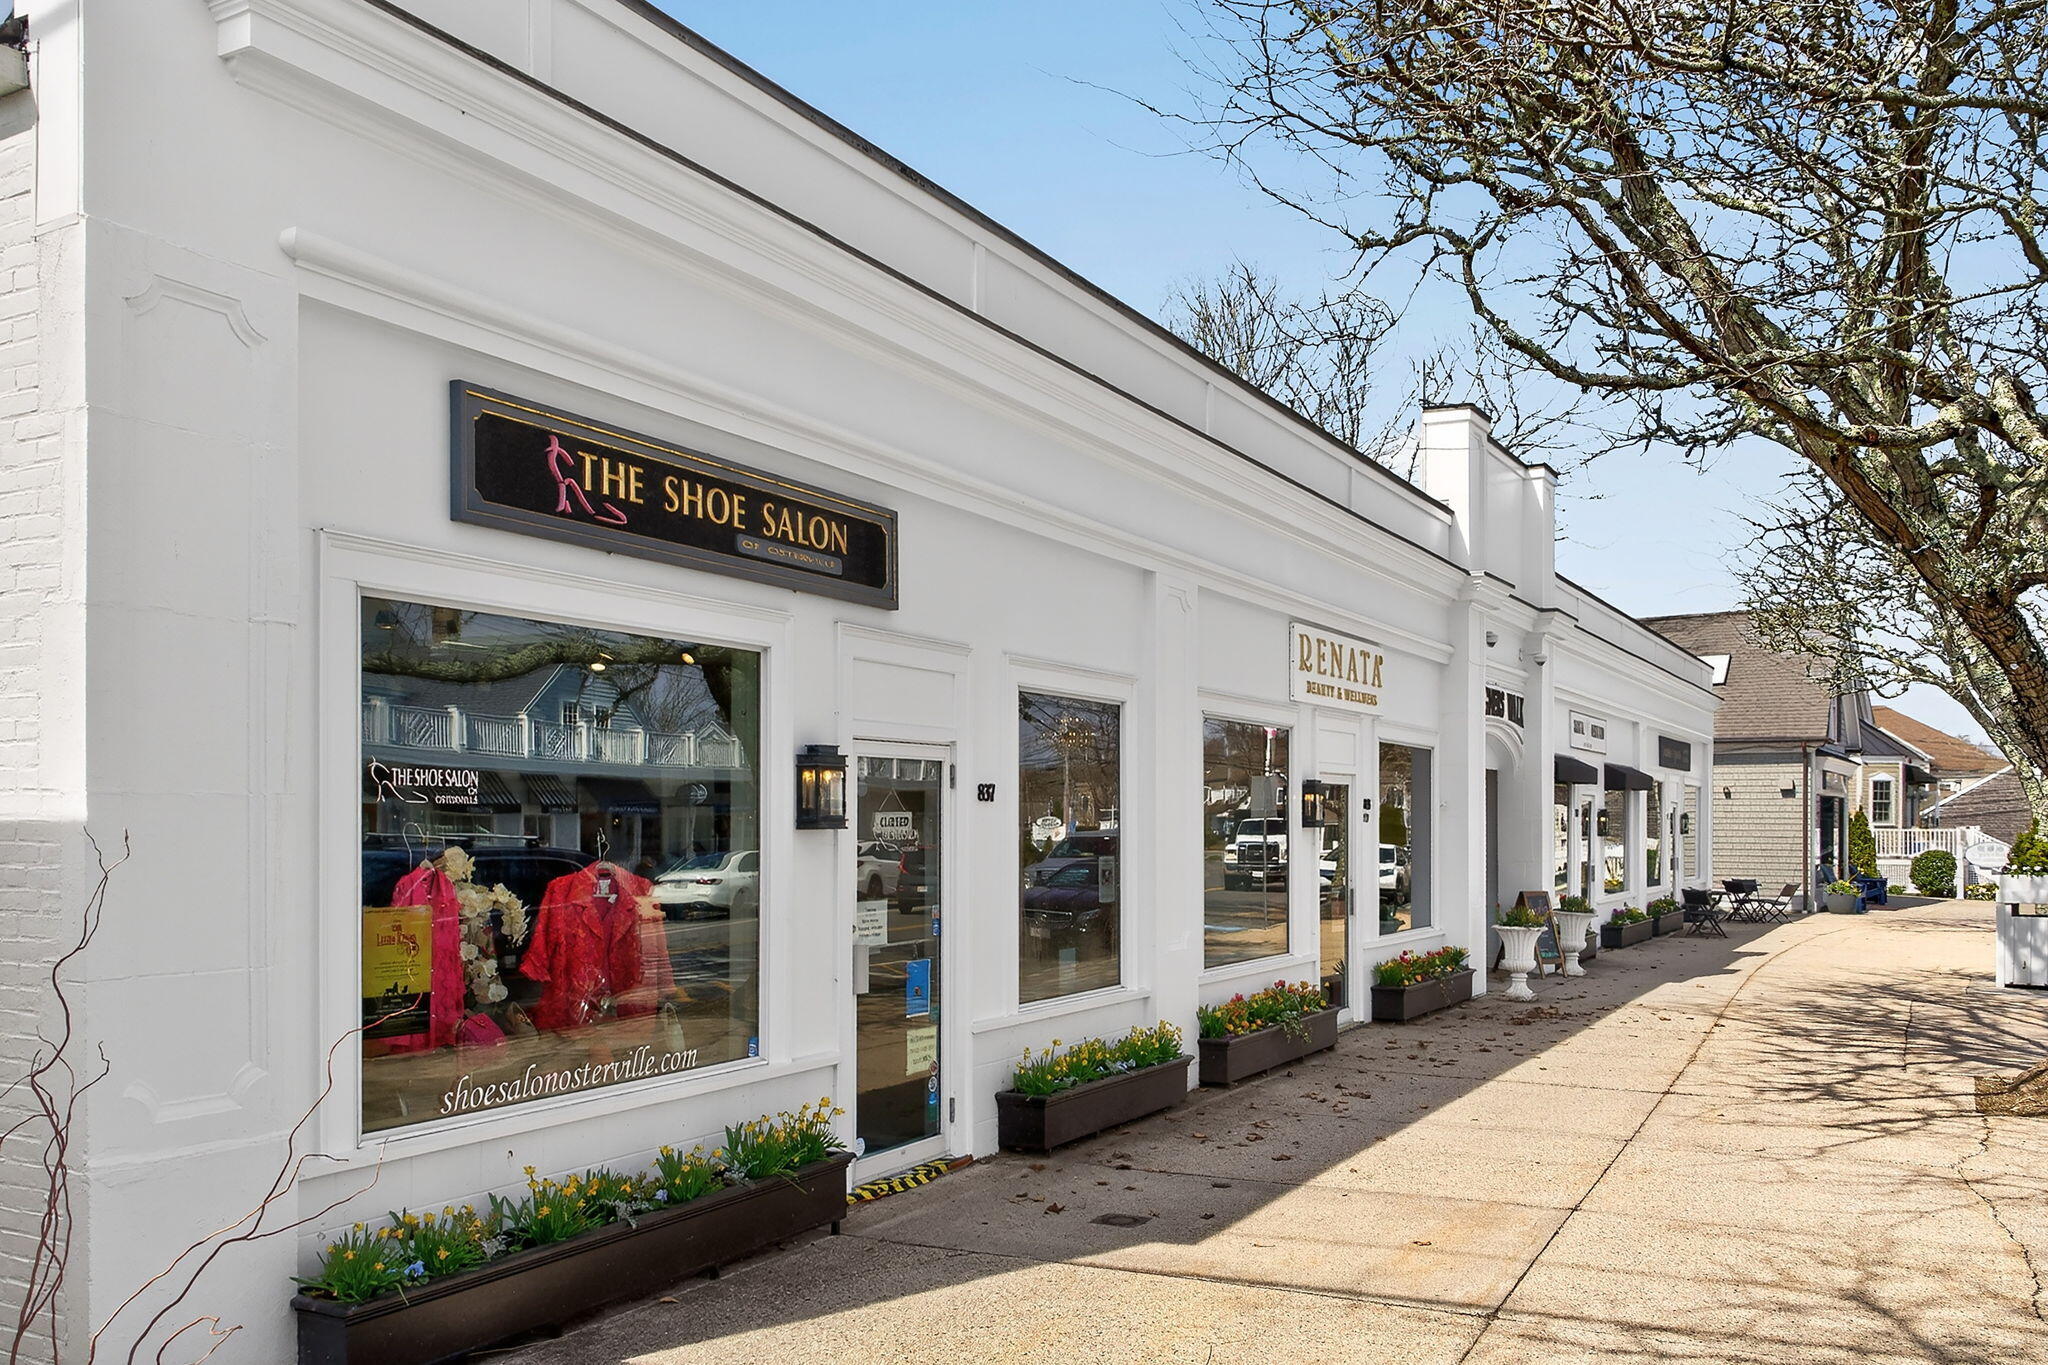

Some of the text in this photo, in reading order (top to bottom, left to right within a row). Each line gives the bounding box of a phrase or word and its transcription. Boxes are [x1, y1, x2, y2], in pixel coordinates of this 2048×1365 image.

[577, 450, 849, 555] THE SHOE SALON
[391, 767, 479, 788] THE SHOE SALON
[977, 783, 996, 802] 837
[440, 1045, 699, 1115] shoesalonosterville.com
